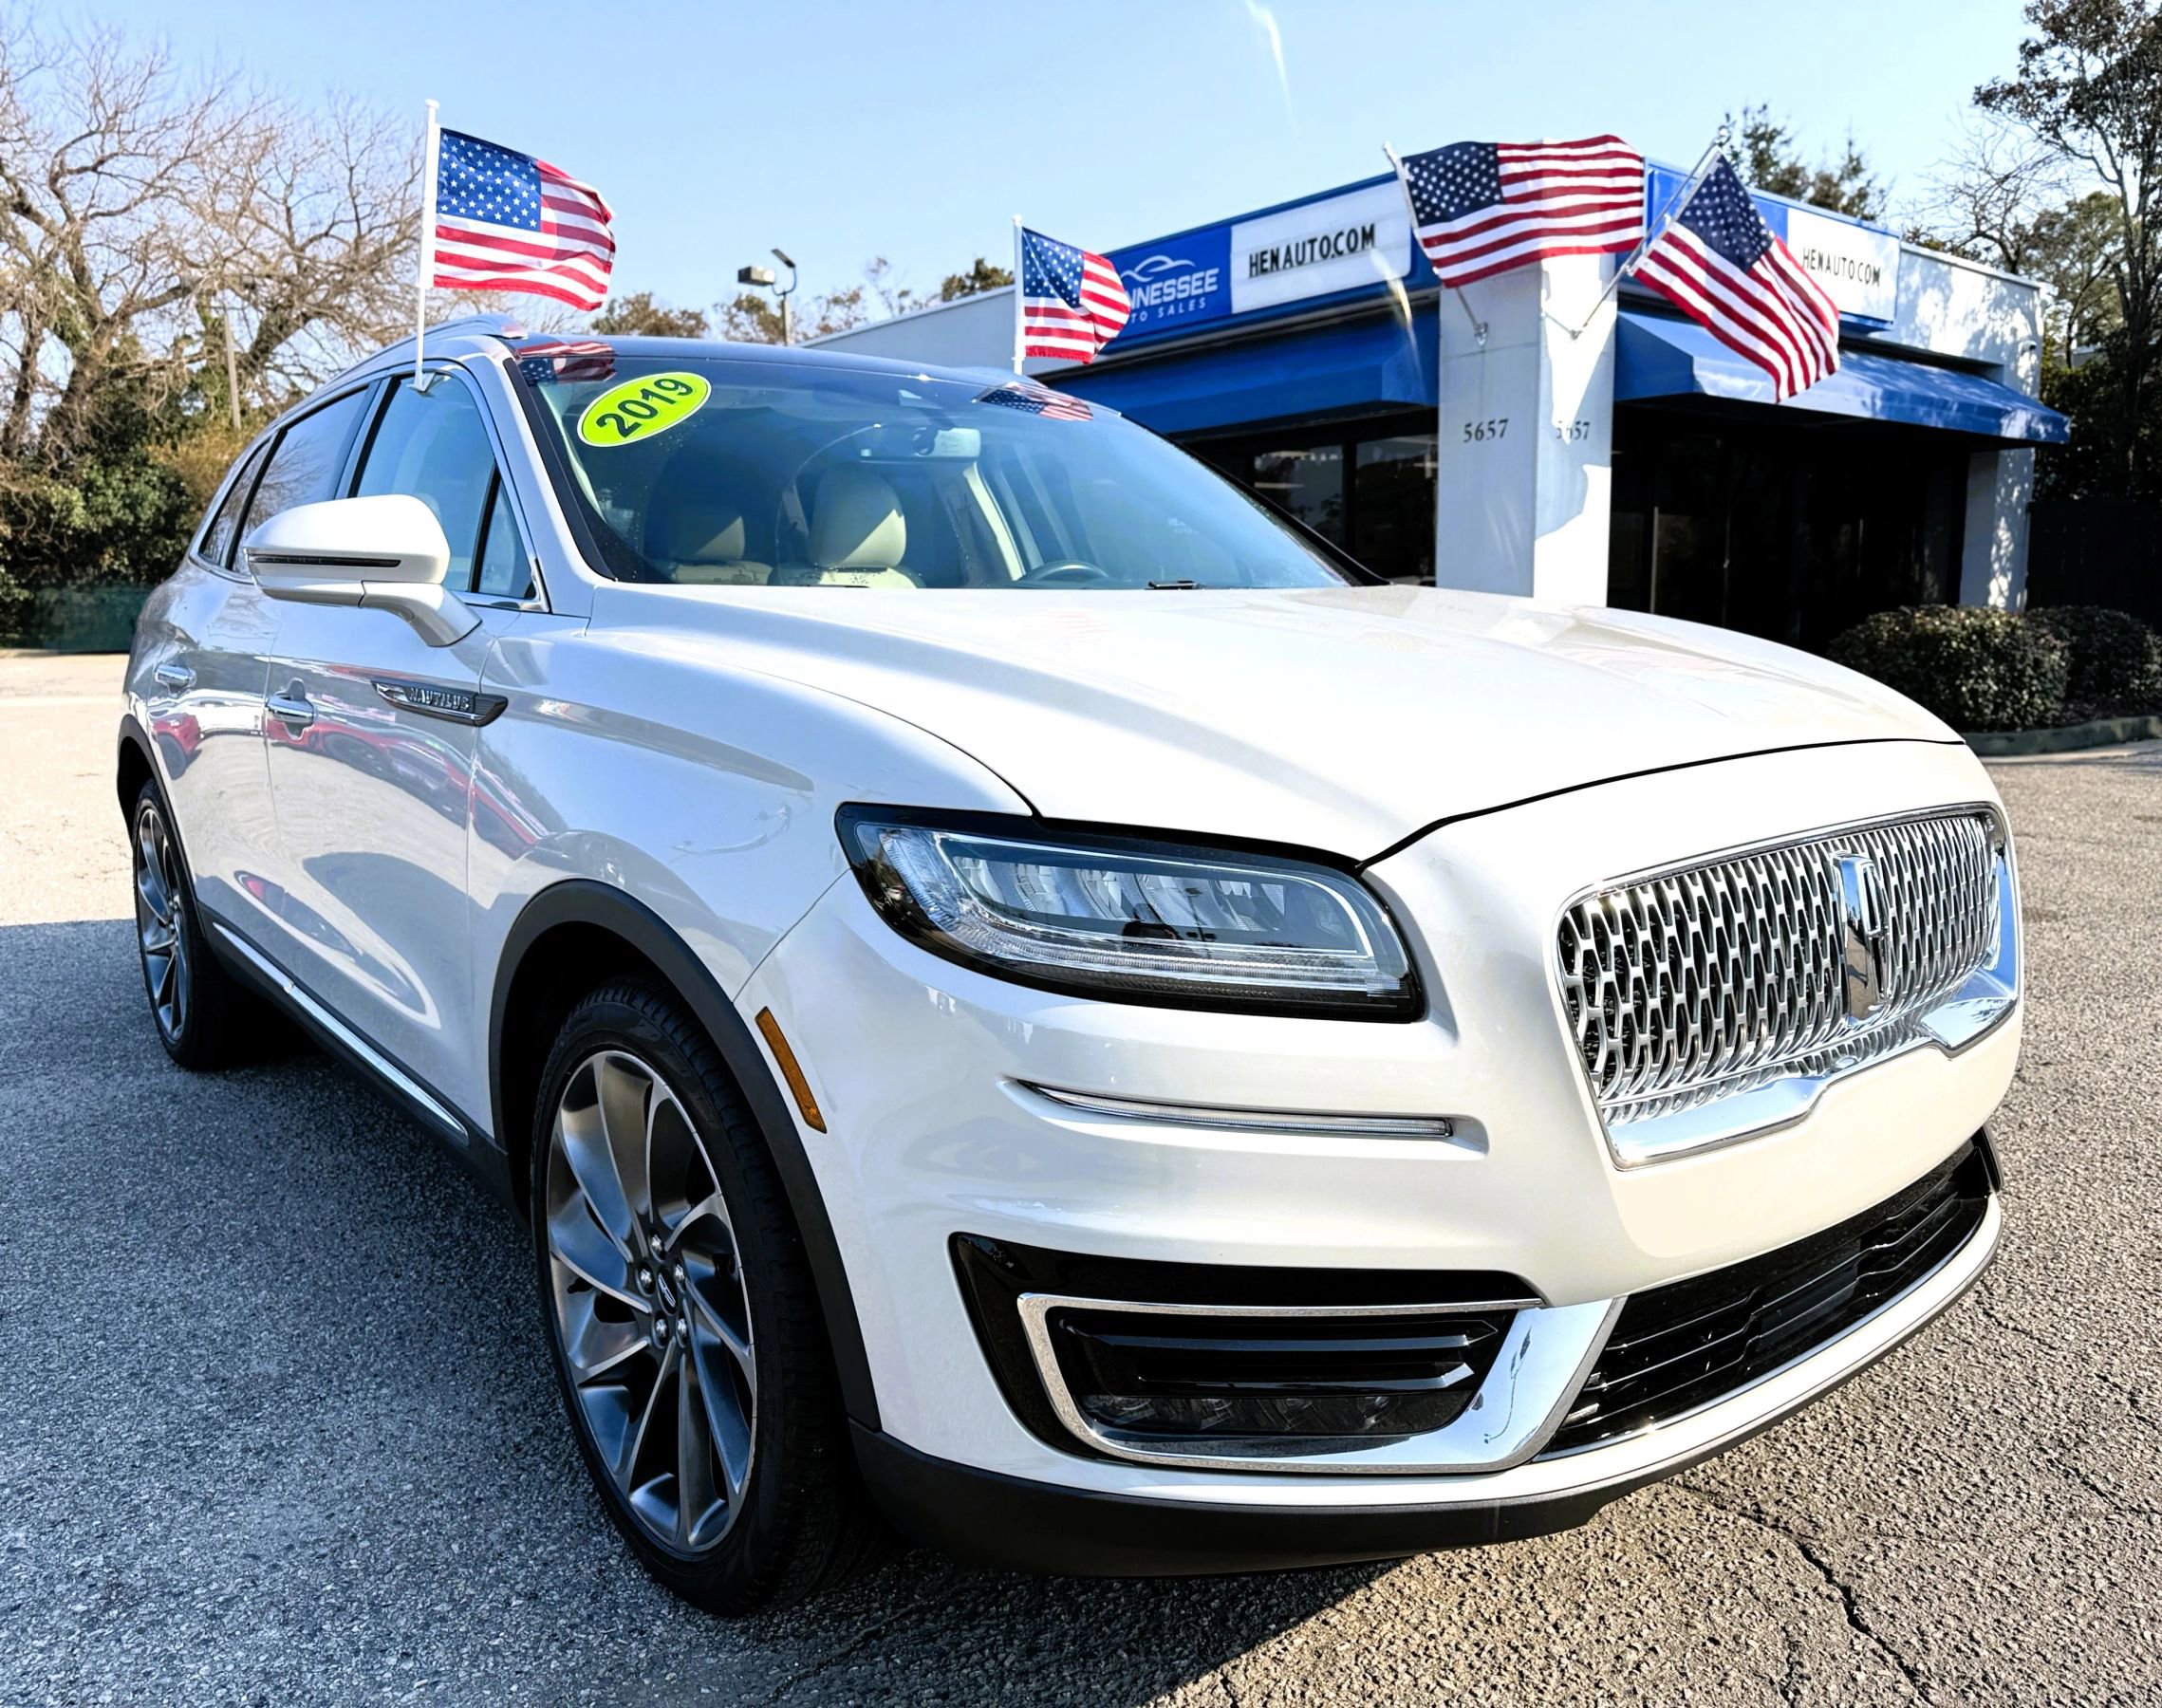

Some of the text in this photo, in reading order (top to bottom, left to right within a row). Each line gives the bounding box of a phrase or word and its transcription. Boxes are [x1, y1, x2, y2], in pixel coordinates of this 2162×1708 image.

[1249, 223, 1375, 278] HENAUTO.COM
[1158, 296, 1206, 319] SALES
[596, 378, 694, 438] 2019
[1463, 418, 1508, 443] 5657
[410, 687, 470, 711] NAUTILUS
